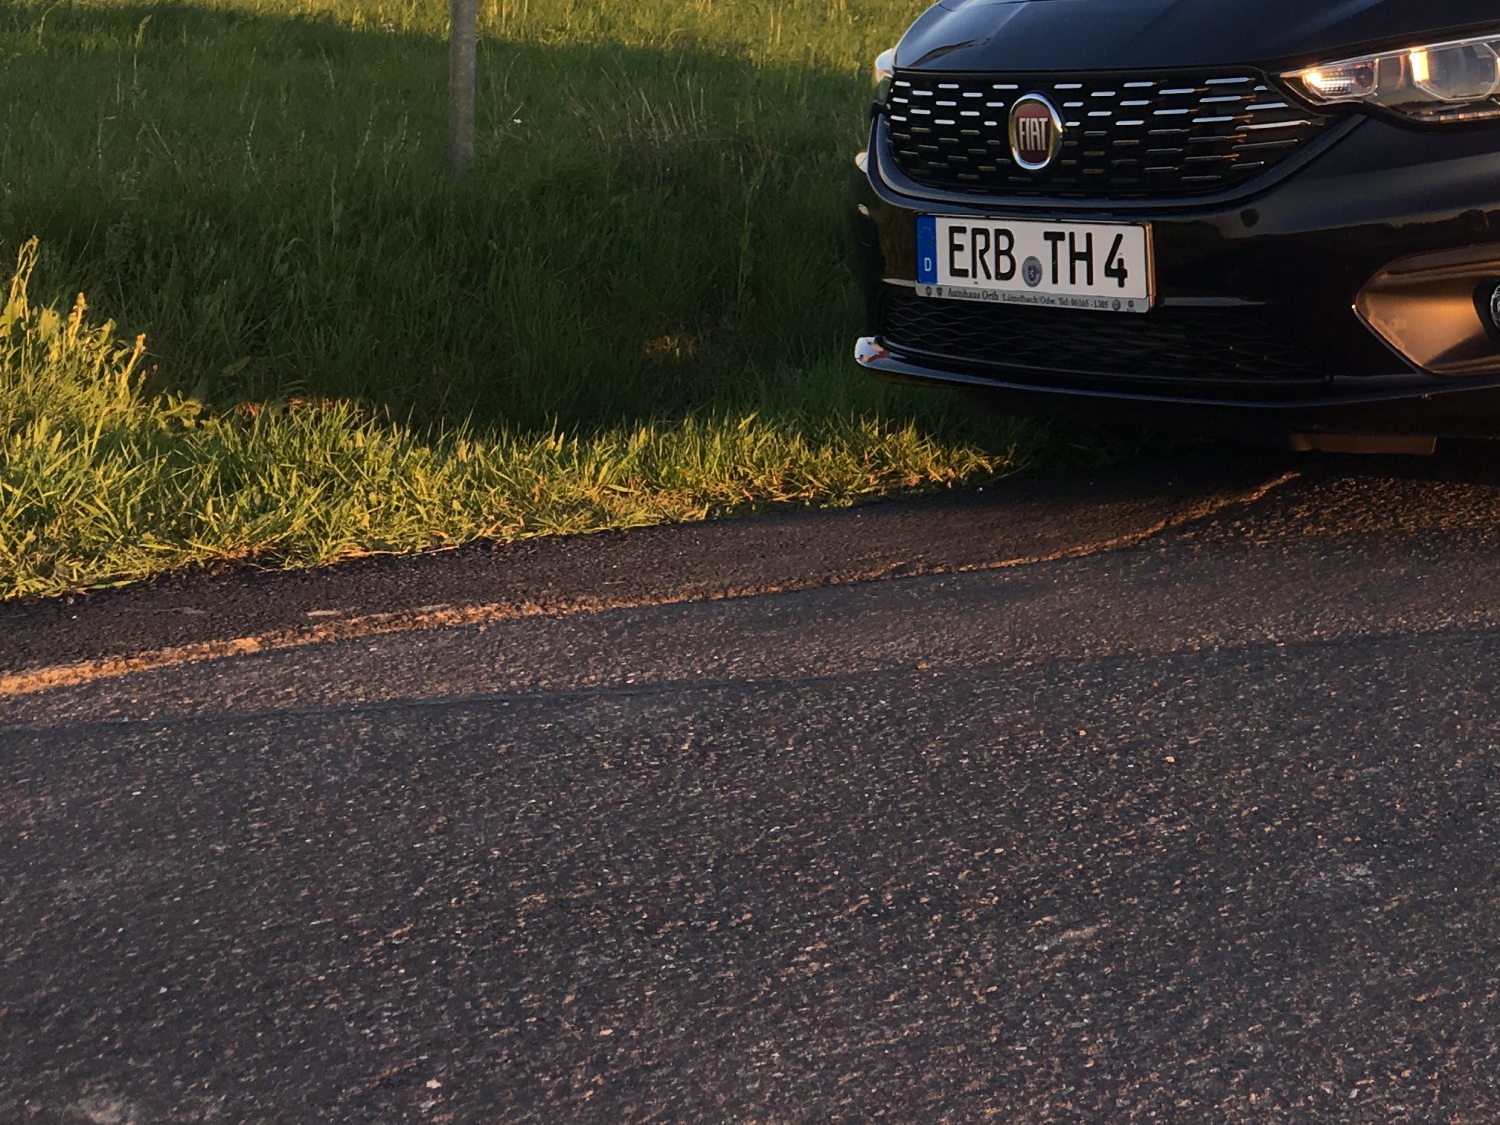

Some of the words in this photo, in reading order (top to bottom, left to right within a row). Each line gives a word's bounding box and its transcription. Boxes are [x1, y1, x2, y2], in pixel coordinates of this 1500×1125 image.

[1018, 117, 1049, 151] FIAT
[924, 257, 933, 273] D
[948, 225, 1017, 282] ERB
[1043, 230, 1094, 286] TH
[1104, 233, 1129, 288] 4
